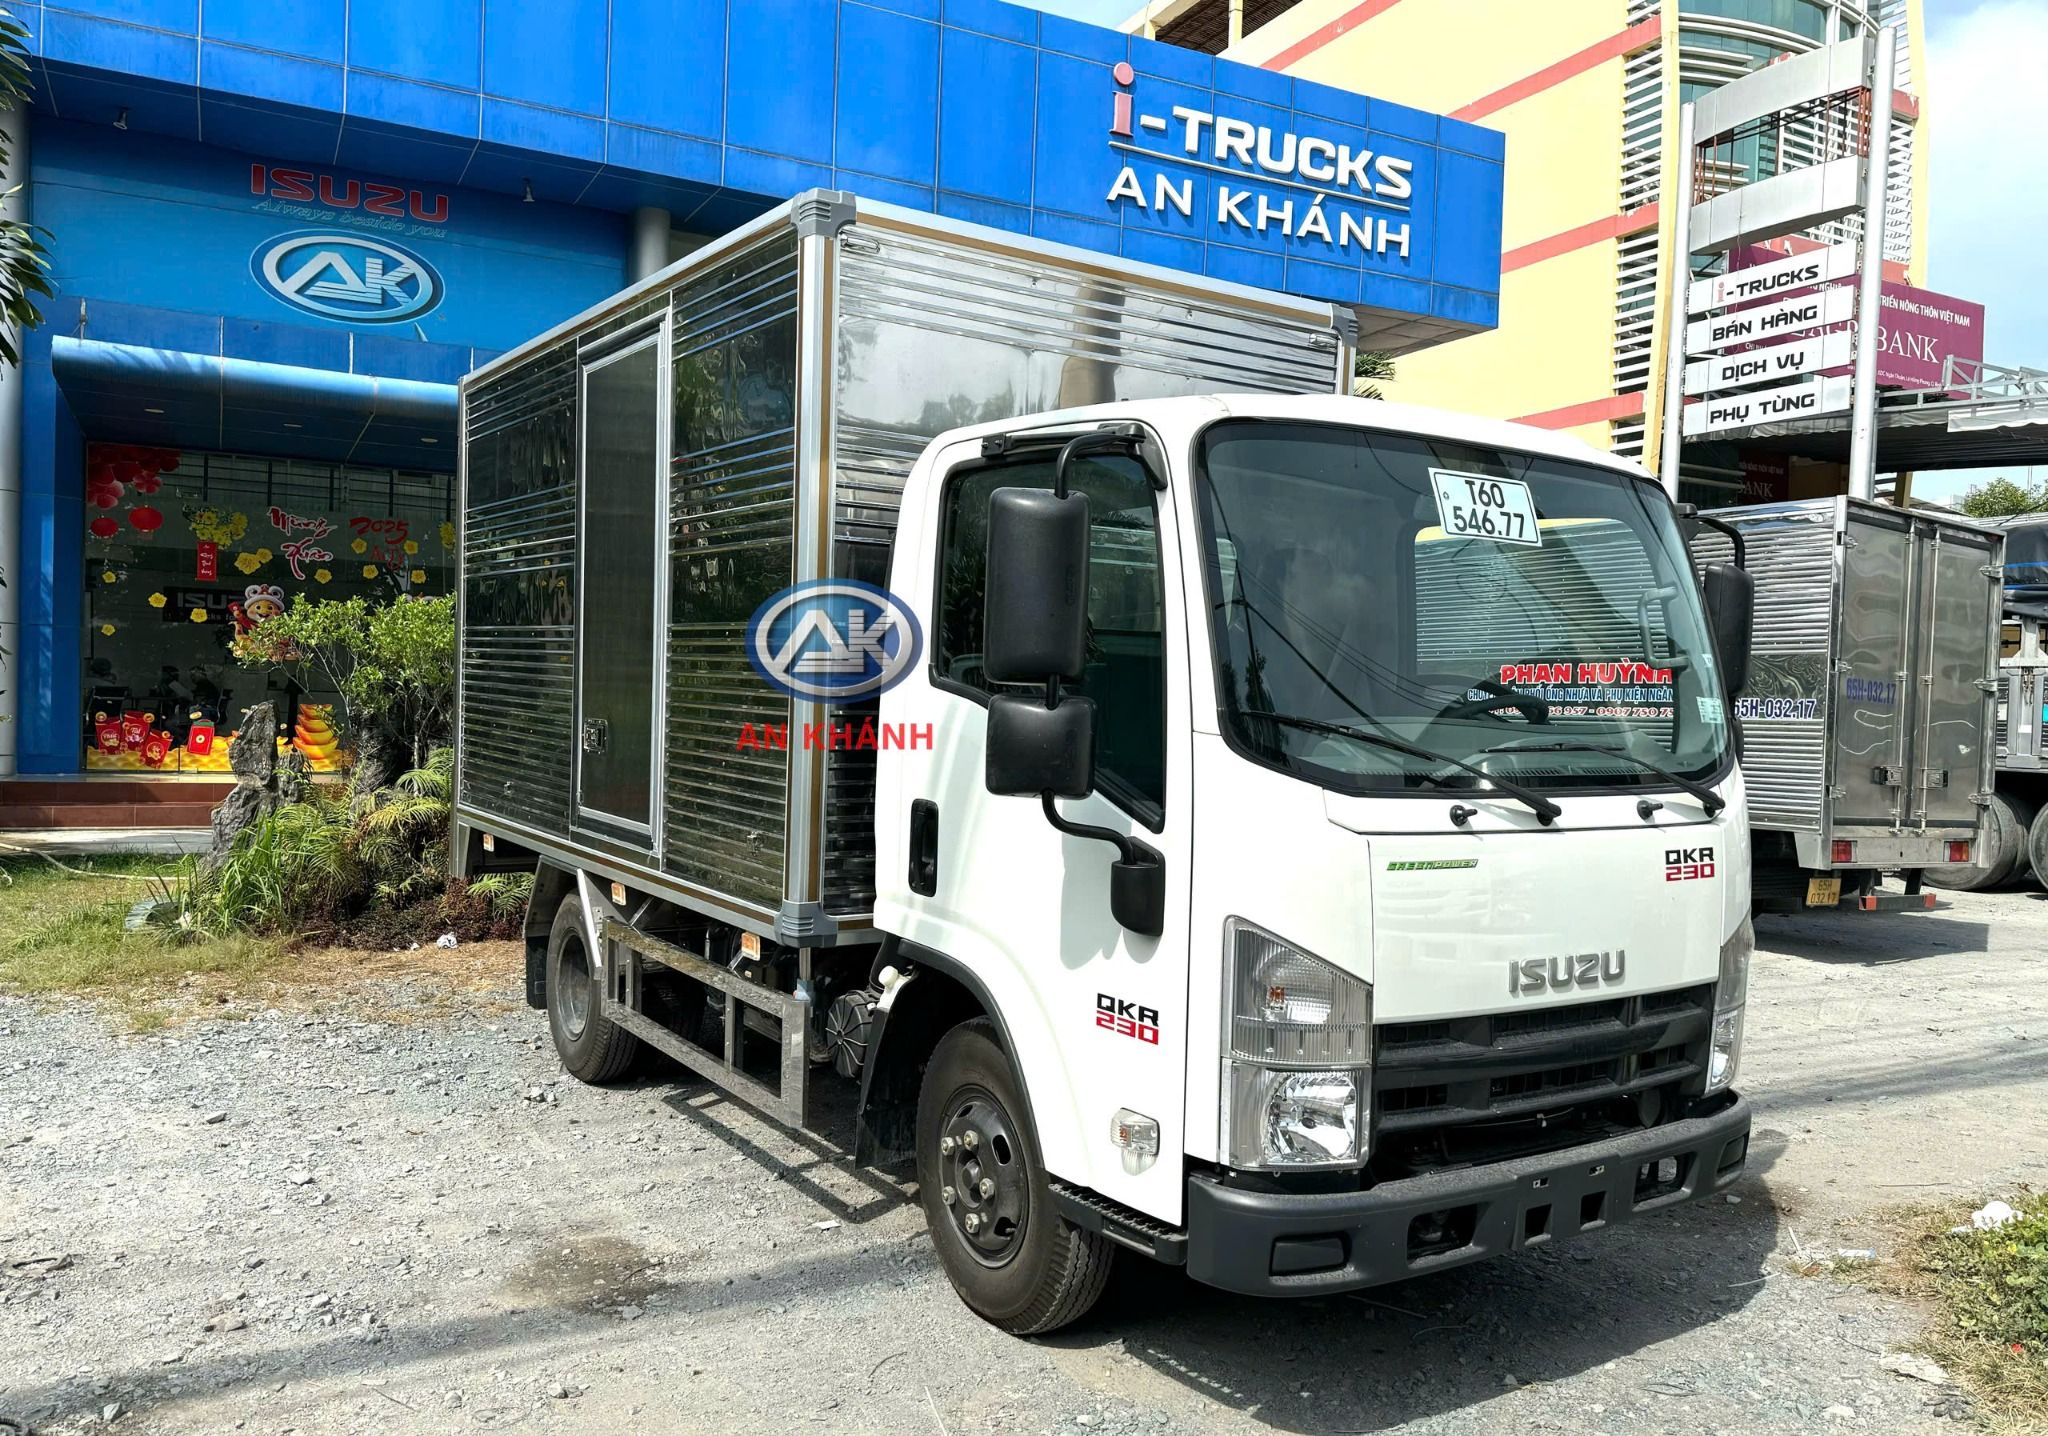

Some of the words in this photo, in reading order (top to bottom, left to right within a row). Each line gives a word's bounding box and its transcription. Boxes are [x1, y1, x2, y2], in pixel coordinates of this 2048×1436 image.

[1109, 62, 1413, 200] i-TRUCKS
[251, 163, 449, 223] ISUZU
[252, 199, 336, 222] Always
[339, 211, 406, 231] beside
[405, 224, 448, 239] you
[1106, 167, 1193, 216] AN
[1217, 193, 1410, 257] KHÁNH
[1717, 264, 1819, 303] i-TRUCKS
[1712, 319, 1752, 342] BÁN
[1760, 305, 1818, 331] HÀNG
[1954, 314, 1971, 327] NAM
[1722, 359, 1767, 382] DỊCH
[1776, 351, 1804, 370] VỤ
[1710, 404, 1750, 424] PHỤ
[1758, 393, 1815, 415] TÙNG
[1464, 480, 1505, 509] T60
[350, 516, 410, 545] 2025
[1453, 505, 1525, 538] 546.77
[1500, 663, 1572, 685] PHAN
[1545, 684, 1564, 702] ỐNG
[1565, 686, 1591, 703] NHỰA
[1591, 685, 1603, 702] VÀ
[1604, 687, 1624, 704] PHỤ
[1624, 685, 1646, 704] KIỆN
[1846, 678, 1896, 705] 65H-032.17
[1631, 707, 1659, 717] 750
[1665, 847, 1715, 866] QKR
[1665, 863, 1715, 882] 230
[1508, 949, 1626, 994] ISUZU
[1097, 992, 1159, 1027] QKR
[1096, 1010, 1159, 1045] 230
